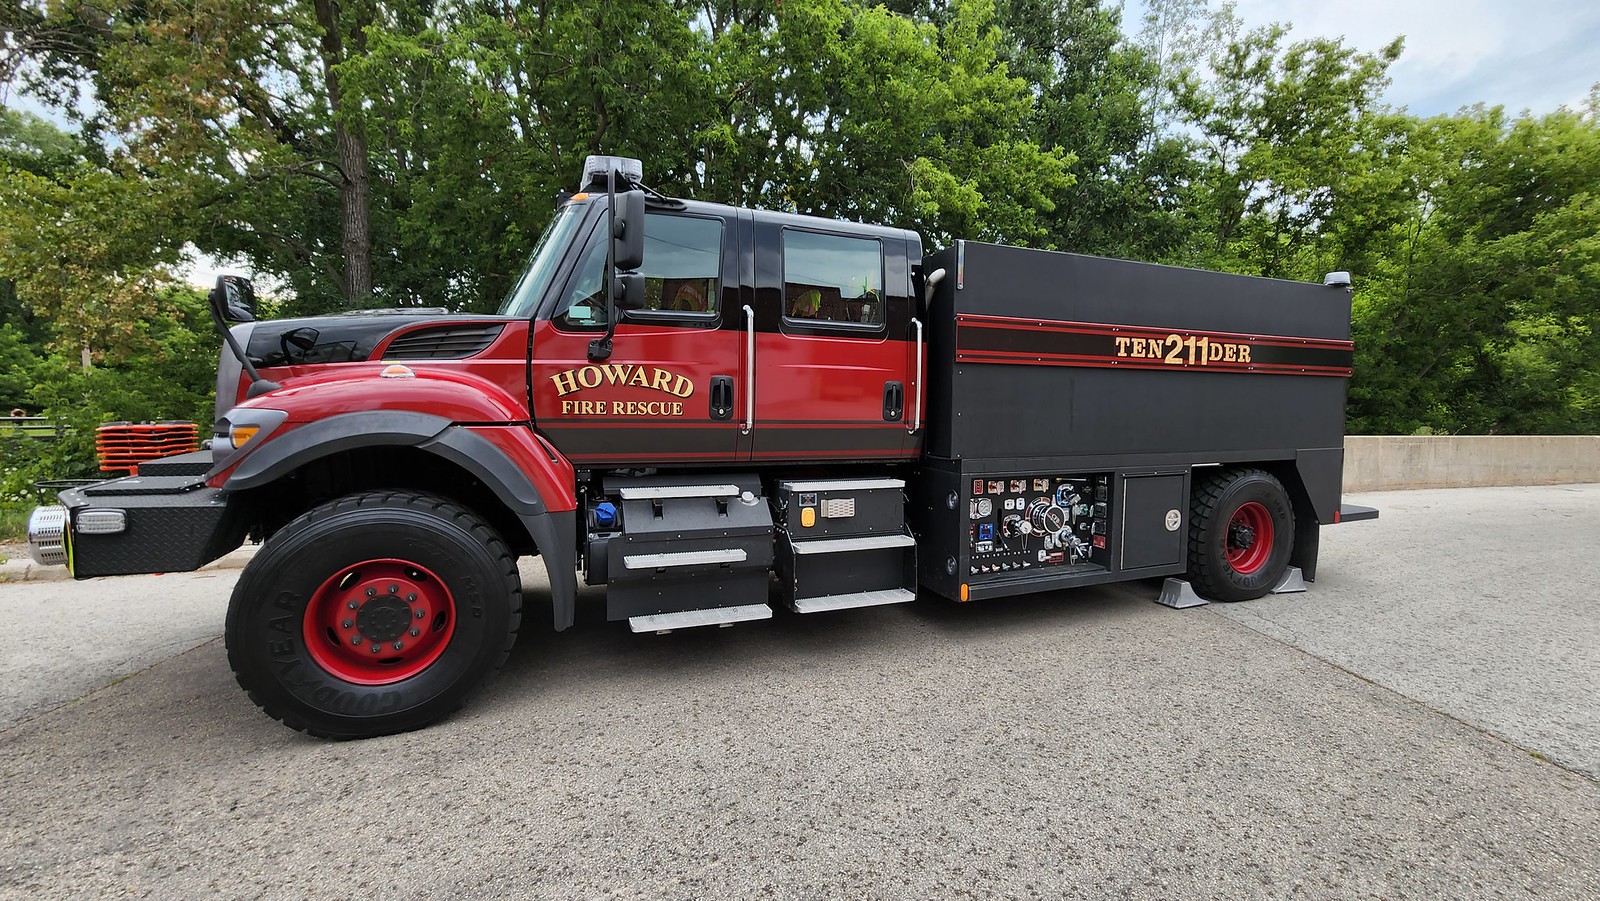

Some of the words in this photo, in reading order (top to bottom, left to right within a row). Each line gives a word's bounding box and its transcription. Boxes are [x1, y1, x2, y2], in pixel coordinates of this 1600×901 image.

[549, 363, 695, 398] HOWARD
[561, 400, 607, 415] FIRE
[612, 401, 684, 416] RESCUE
[268, 589, 403, 714] GOODYEAR
